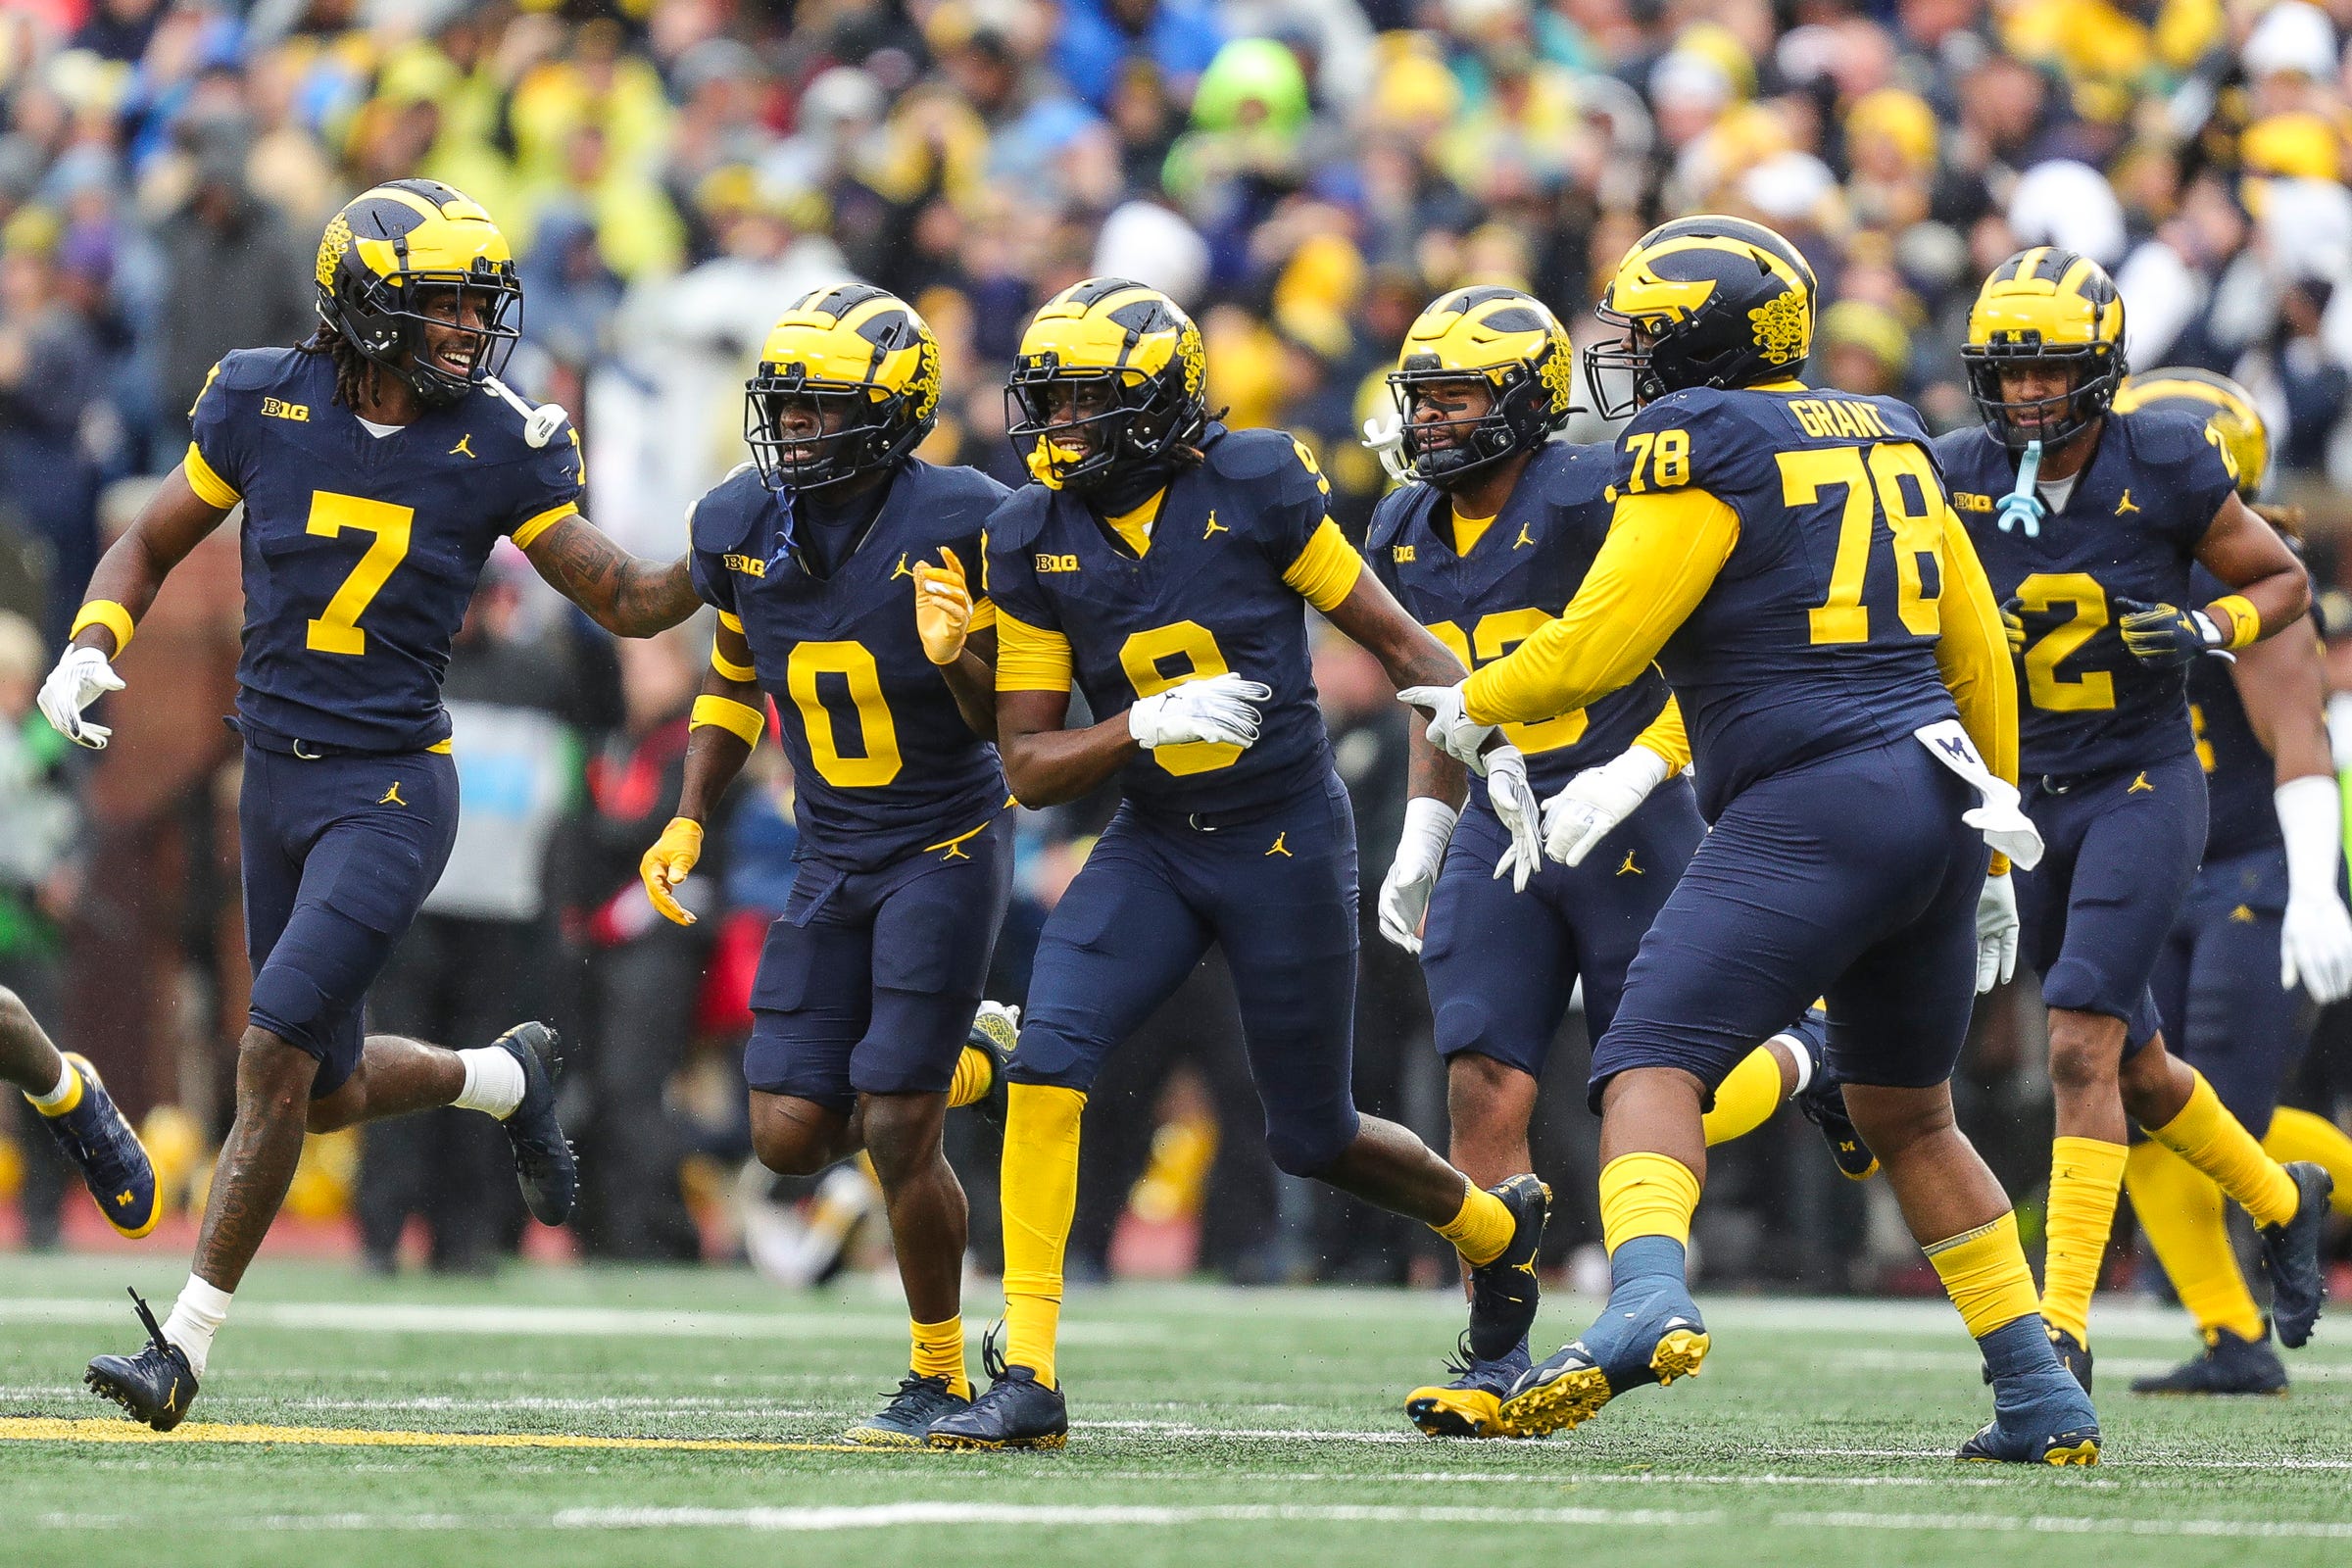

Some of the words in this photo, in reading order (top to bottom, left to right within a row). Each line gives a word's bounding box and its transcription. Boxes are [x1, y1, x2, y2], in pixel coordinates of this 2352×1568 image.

[774, 363, 788, 375] M
[1029, 355, 1042, 368] M
[1788, 399, 1895, 438] GRANT
[1625, 428, 1690, 494] 78
[1774, 442, 1947, 645] 78
[305, 489, 416, 656] 7
[2015, 571, 2117, 711] 2
[787, 640, 904, 787] 0
[1935, 736, 1976, 763] M
[1838, 1140, 1856, 1152] M
